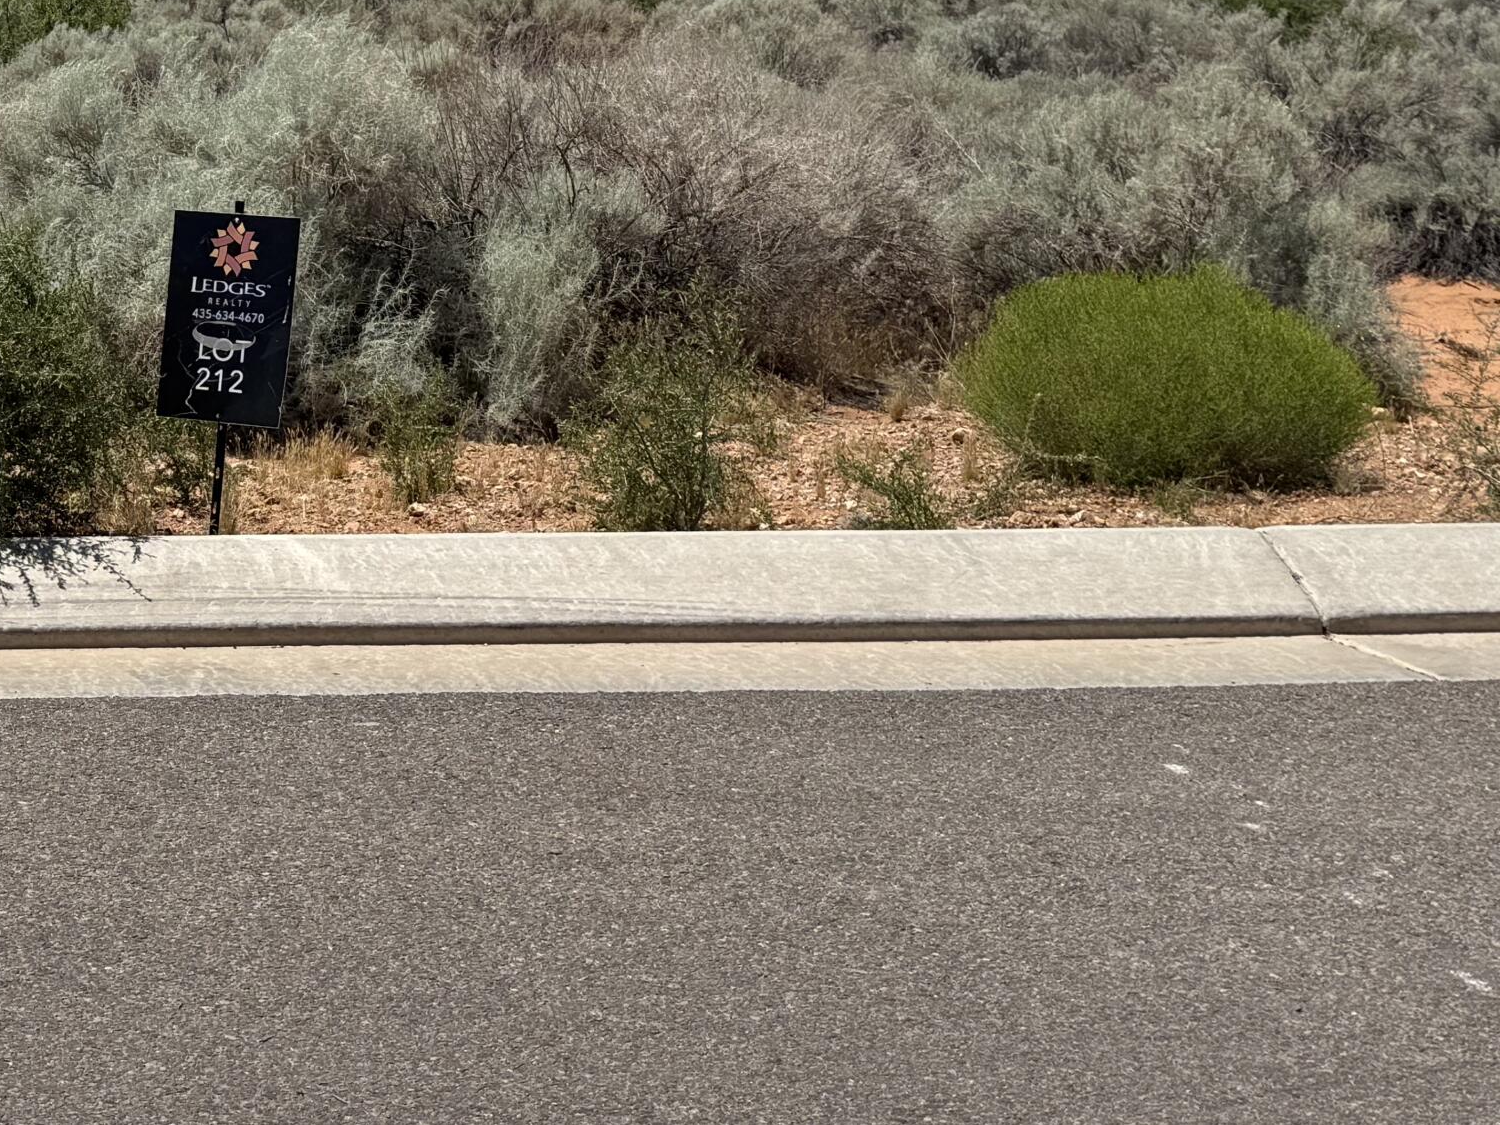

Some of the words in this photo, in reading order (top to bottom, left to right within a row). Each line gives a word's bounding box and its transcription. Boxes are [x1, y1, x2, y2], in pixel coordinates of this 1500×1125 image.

[190, 276, 266, 298] LEDGES
[207, 297, 251, 307] REALTY
[191, 308, 265, 324] 435-634-4670
[198, 337, 254, 364] LOT
[195, 367, 244, 394] 212
